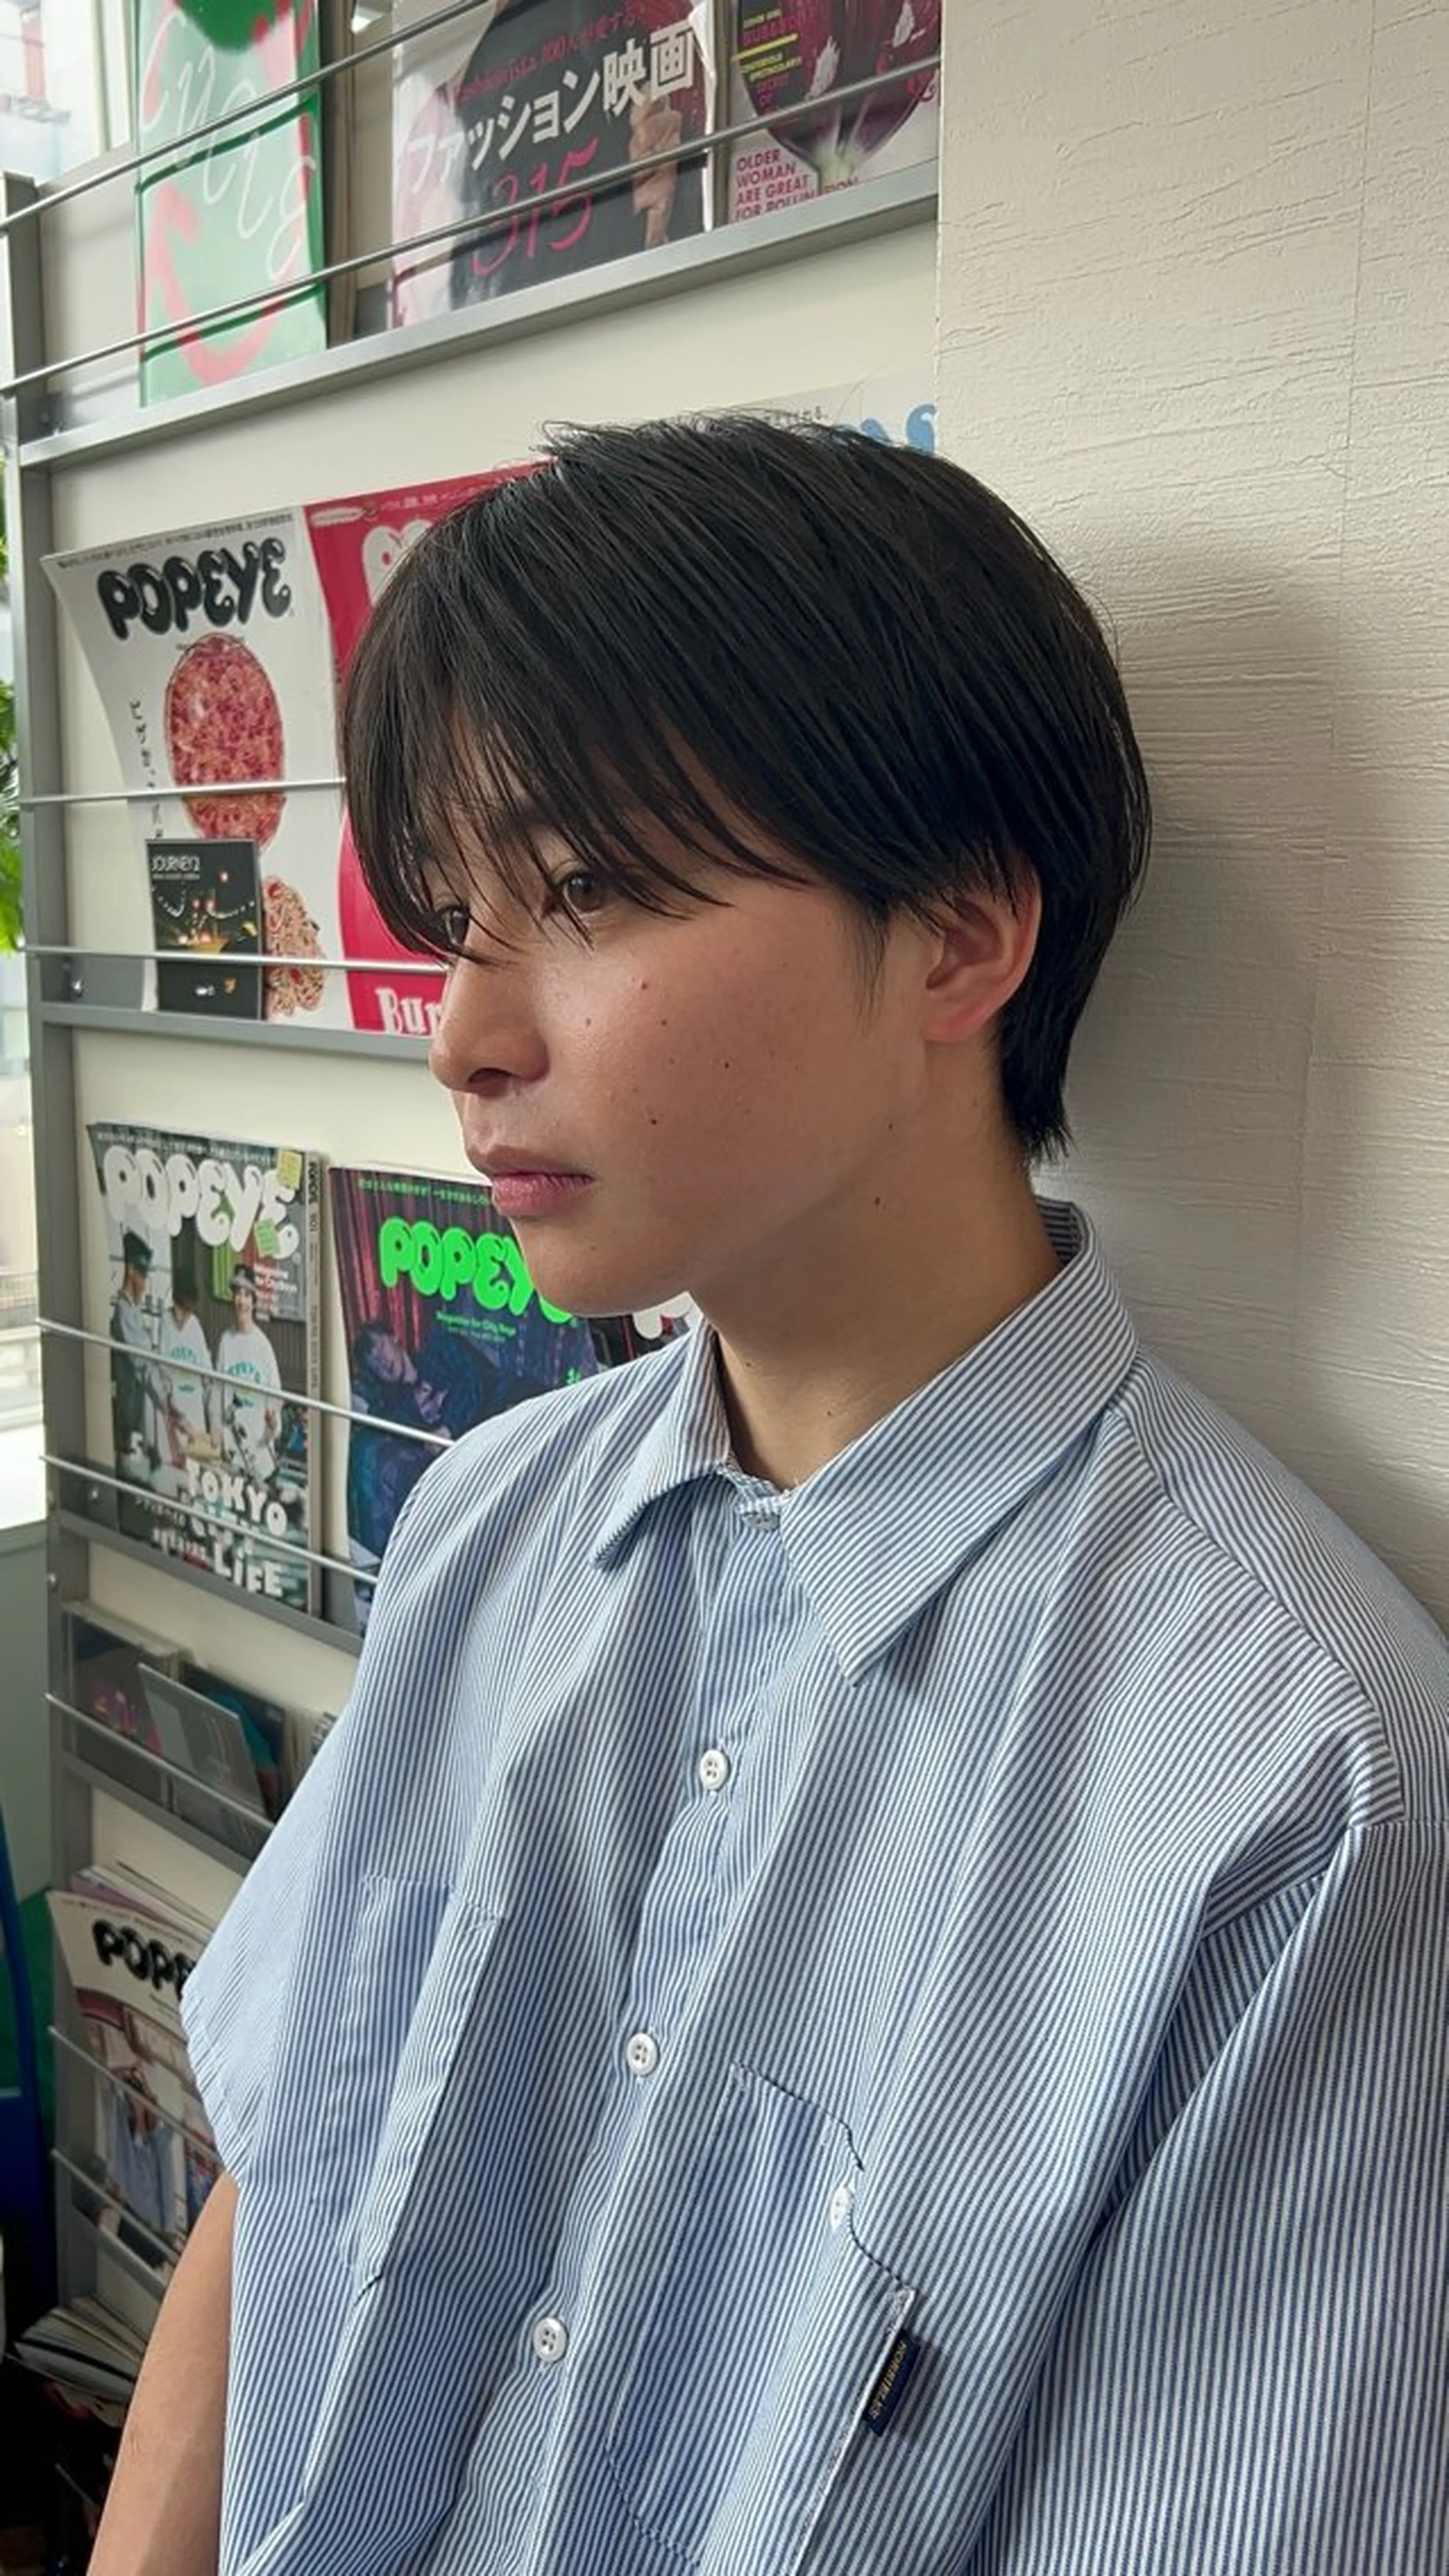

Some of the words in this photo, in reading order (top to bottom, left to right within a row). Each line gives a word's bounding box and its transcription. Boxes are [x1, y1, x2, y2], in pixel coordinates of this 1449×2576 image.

[406, 20, 694, 193] ファッション映画
[472, 137, 598, 276] 315
[737, 148, 780, 171] OLDER
[737, 162, 796, 188] WOMAN
[737, 188, 761, 205] ARE
[766, 174, 808, 198] GREAT
[97, 537, 291, 641] POPEYE
[103, 1145, 300, 1260] POPEYE
[380, 1216, 573, 1323] POPEY
[185, 1458, 288, 1537] TOKYO
